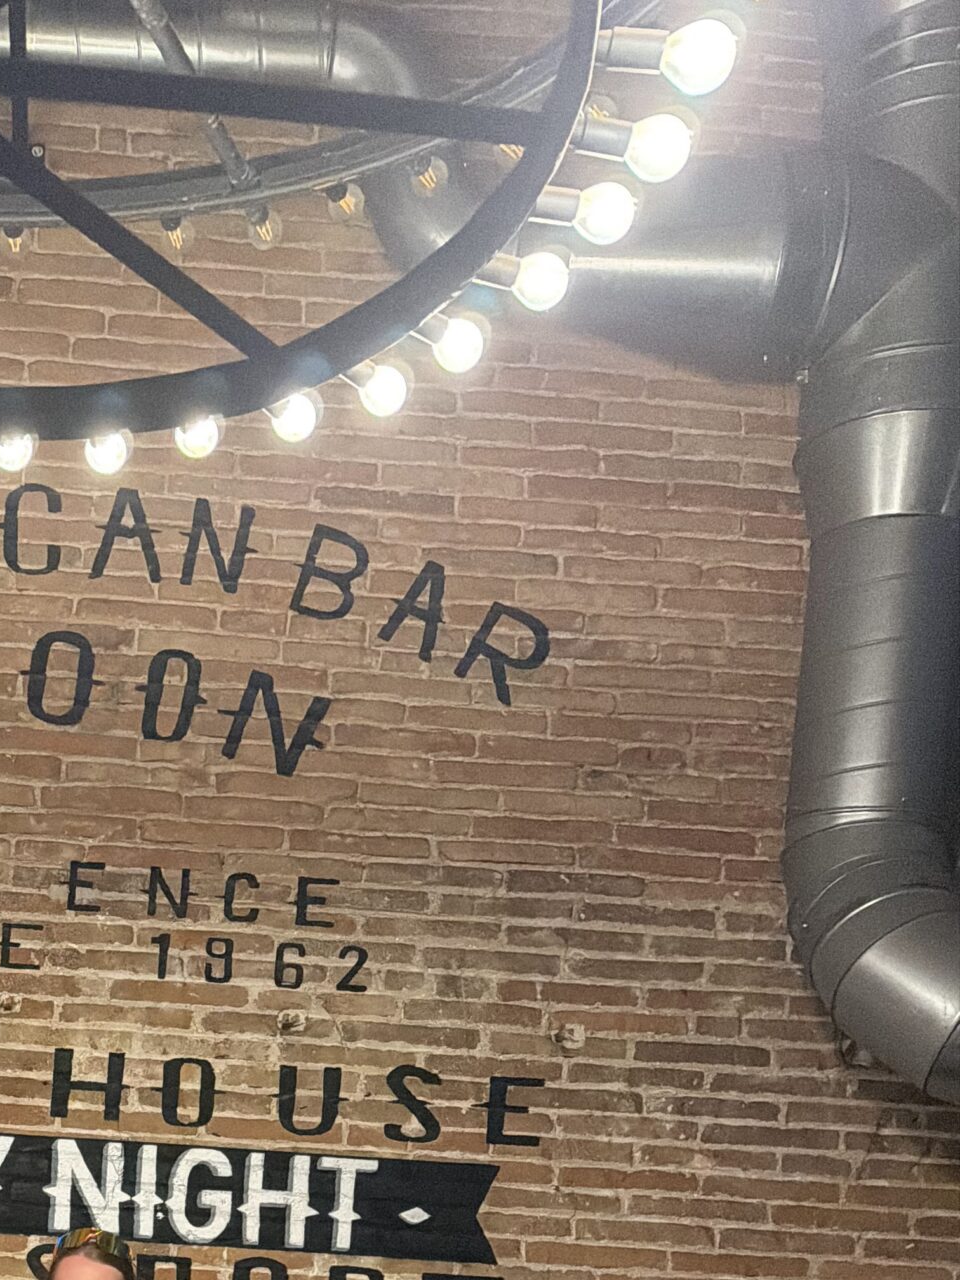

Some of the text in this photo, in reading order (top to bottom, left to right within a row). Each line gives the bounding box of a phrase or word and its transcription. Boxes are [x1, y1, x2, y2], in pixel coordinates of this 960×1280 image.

[289, 523, 550, 706] BAR
[149, 932, 369, 993] 1962
[42, 1047, 546, 1147] HOUSE
[41, 1136, 380, 1252] NIGHT
